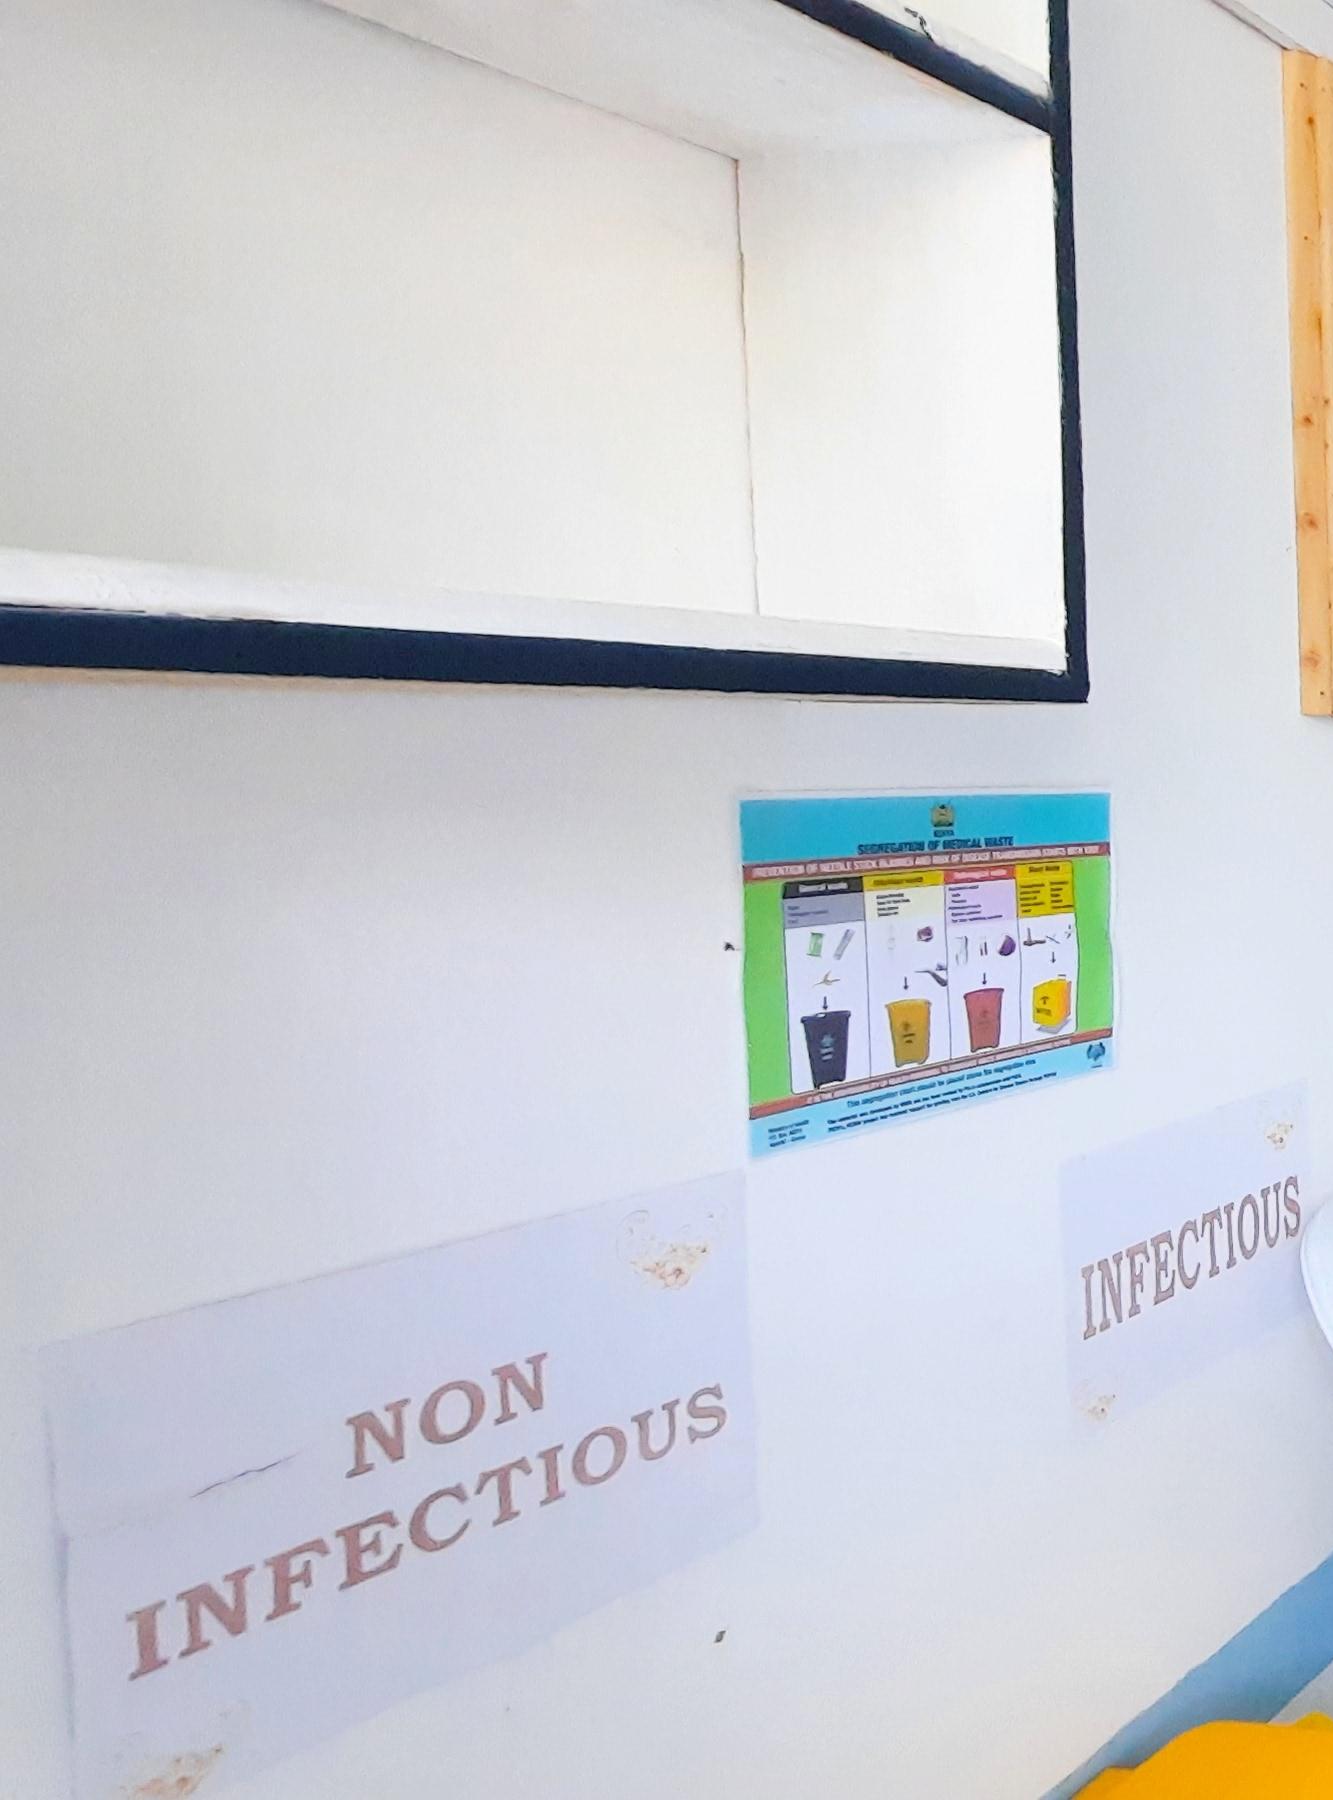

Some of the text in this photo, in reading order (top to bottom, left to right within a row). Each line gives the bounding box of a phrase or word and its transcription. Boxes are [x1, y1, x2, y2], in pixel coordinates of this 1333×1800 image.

[857, 836, 1014, 855] SEGREGATION OF MEDICAL WASTE
[1082, 1176, 1304, 1341] INFECTIOUS
[345, 1352, 550, 1480] NON
[125, 1384, 732, 1682] INFECTIOUS
